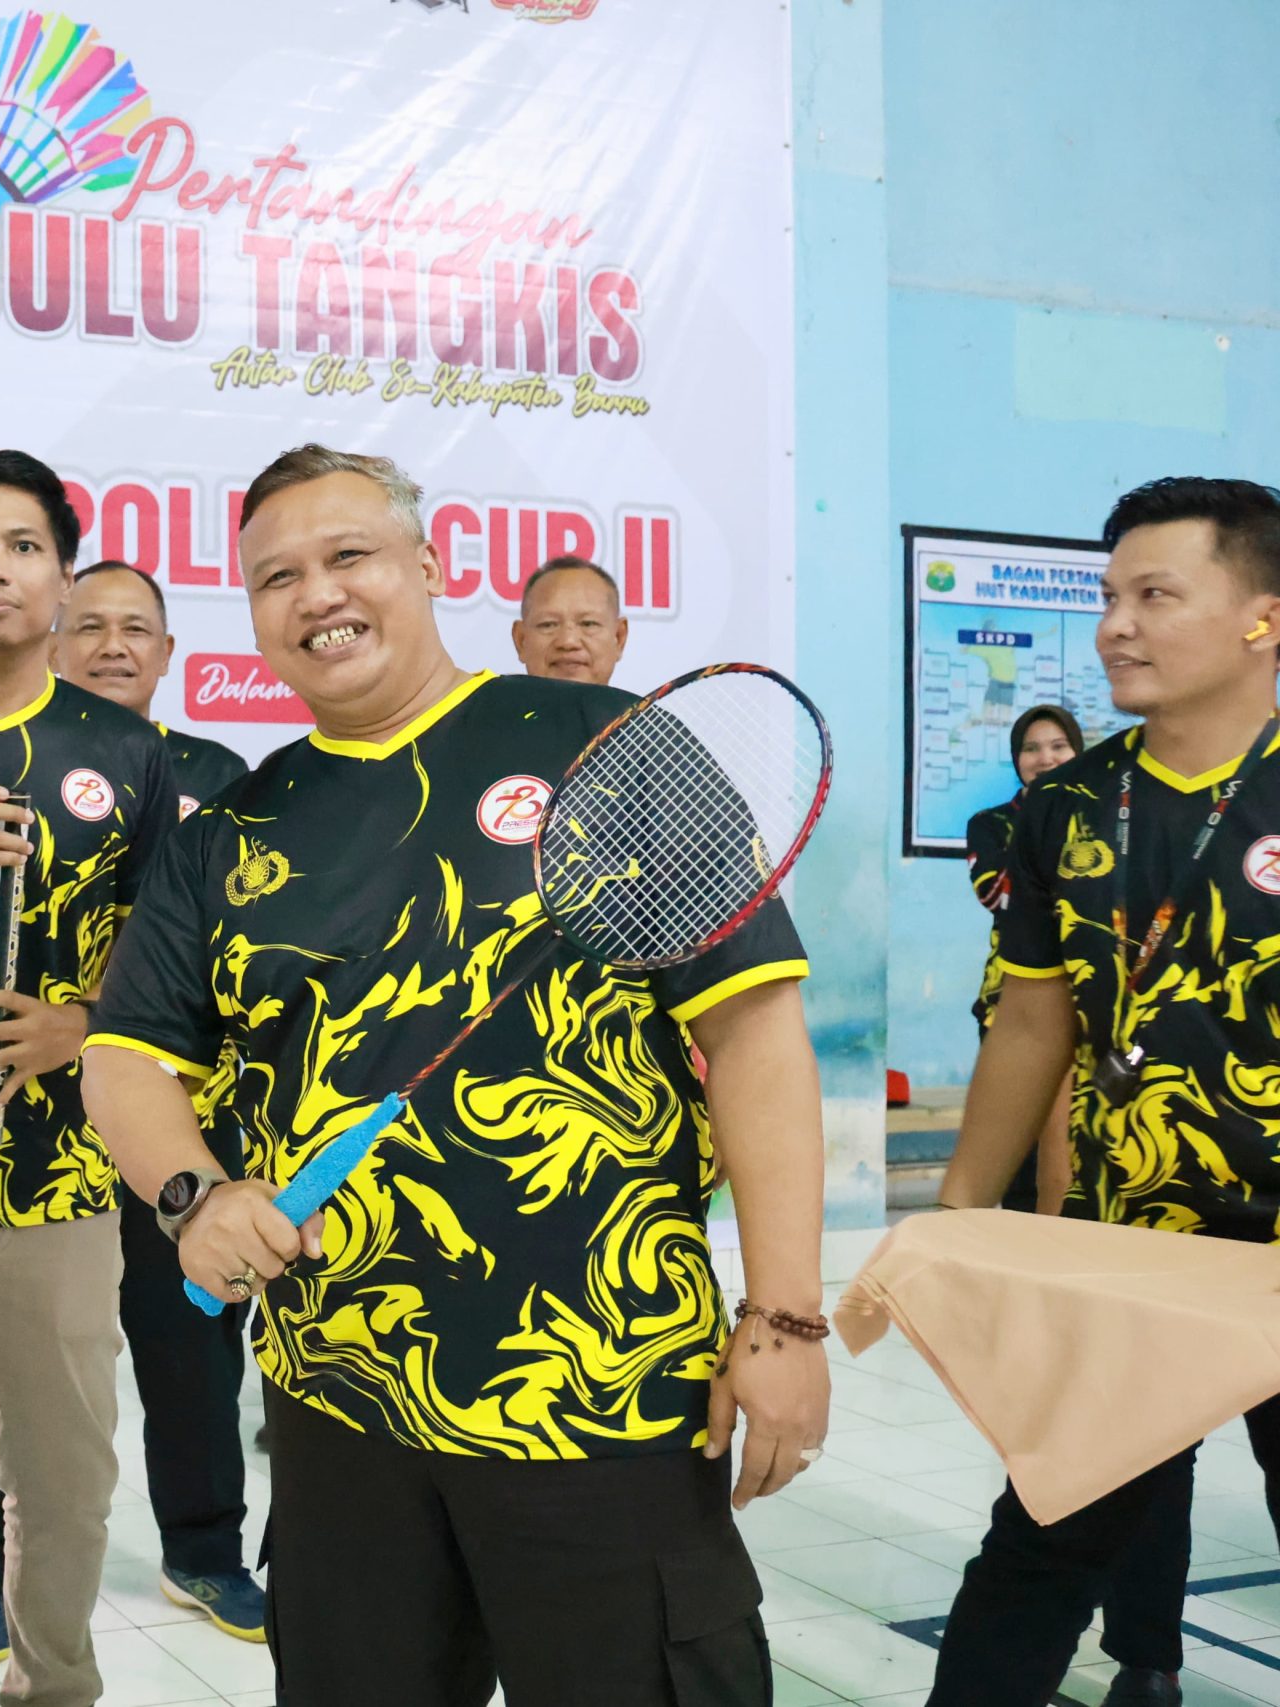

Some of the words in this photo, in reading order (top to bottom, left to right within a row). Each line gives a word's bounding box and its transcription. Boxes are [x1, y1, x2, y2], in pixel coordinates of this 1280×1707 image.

[112, 117, 593, 272] Pertandingan
[242, 236, 640, 382] TANGKIS
[211, 345, 297, 391] Antar
[304, 353, 374, 397] Club
[431, 503, 596, 602] CUP
[624, 516, 670, 609] II
[991, 564, 1046, 582] BAGAN
[975, 581, 1006, 598] HUT
[1009, 583, 1098, 604] KABUPATEN
[975, 631, 1016, 645] SKPD
